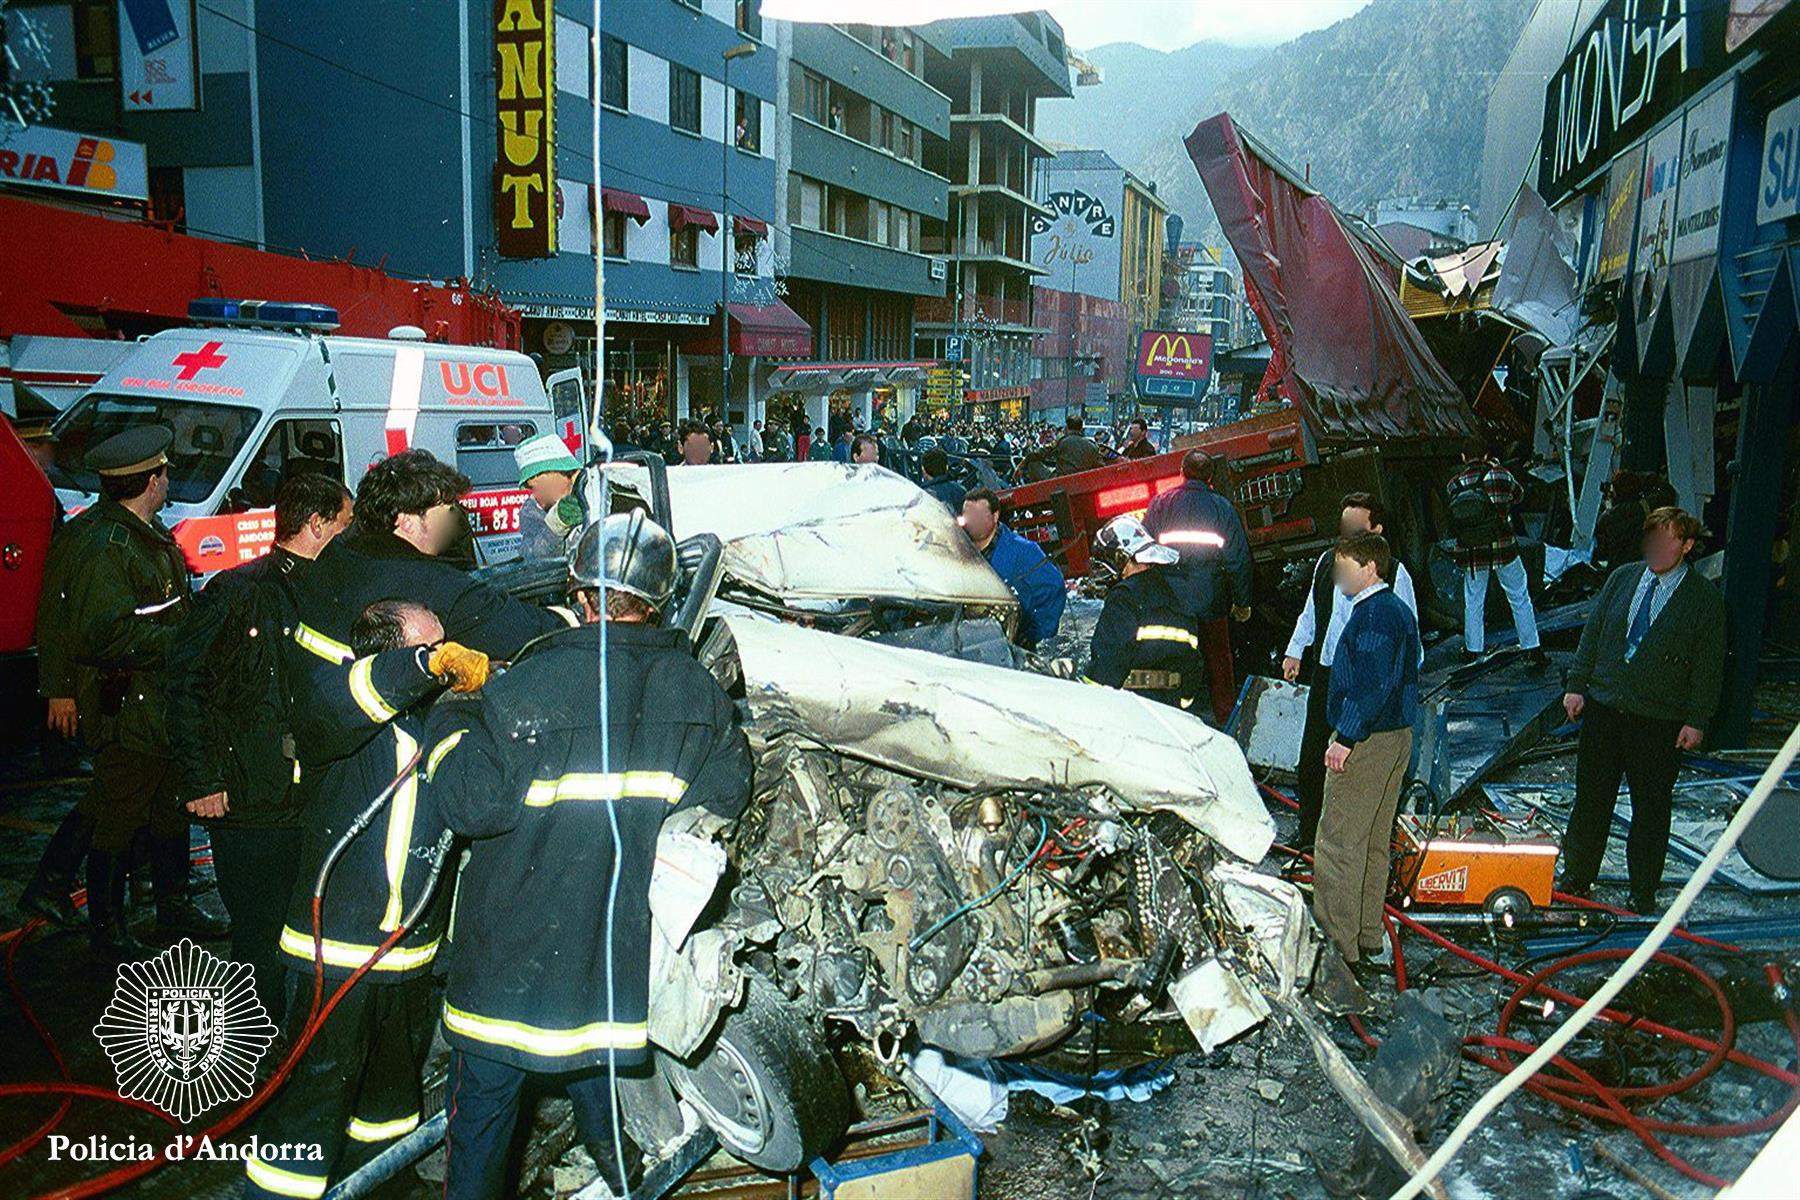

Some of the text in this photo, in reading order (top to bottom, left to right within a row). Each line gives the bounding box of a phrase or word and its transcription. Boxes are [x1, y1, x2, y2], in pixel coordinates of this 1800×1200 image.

[1764, 124, 1800, 208] SU
[1034, 196, 1112, 235] CNTRE
[440, 361, 510, 397] UCI
[492, 508, 508, 531] 82
